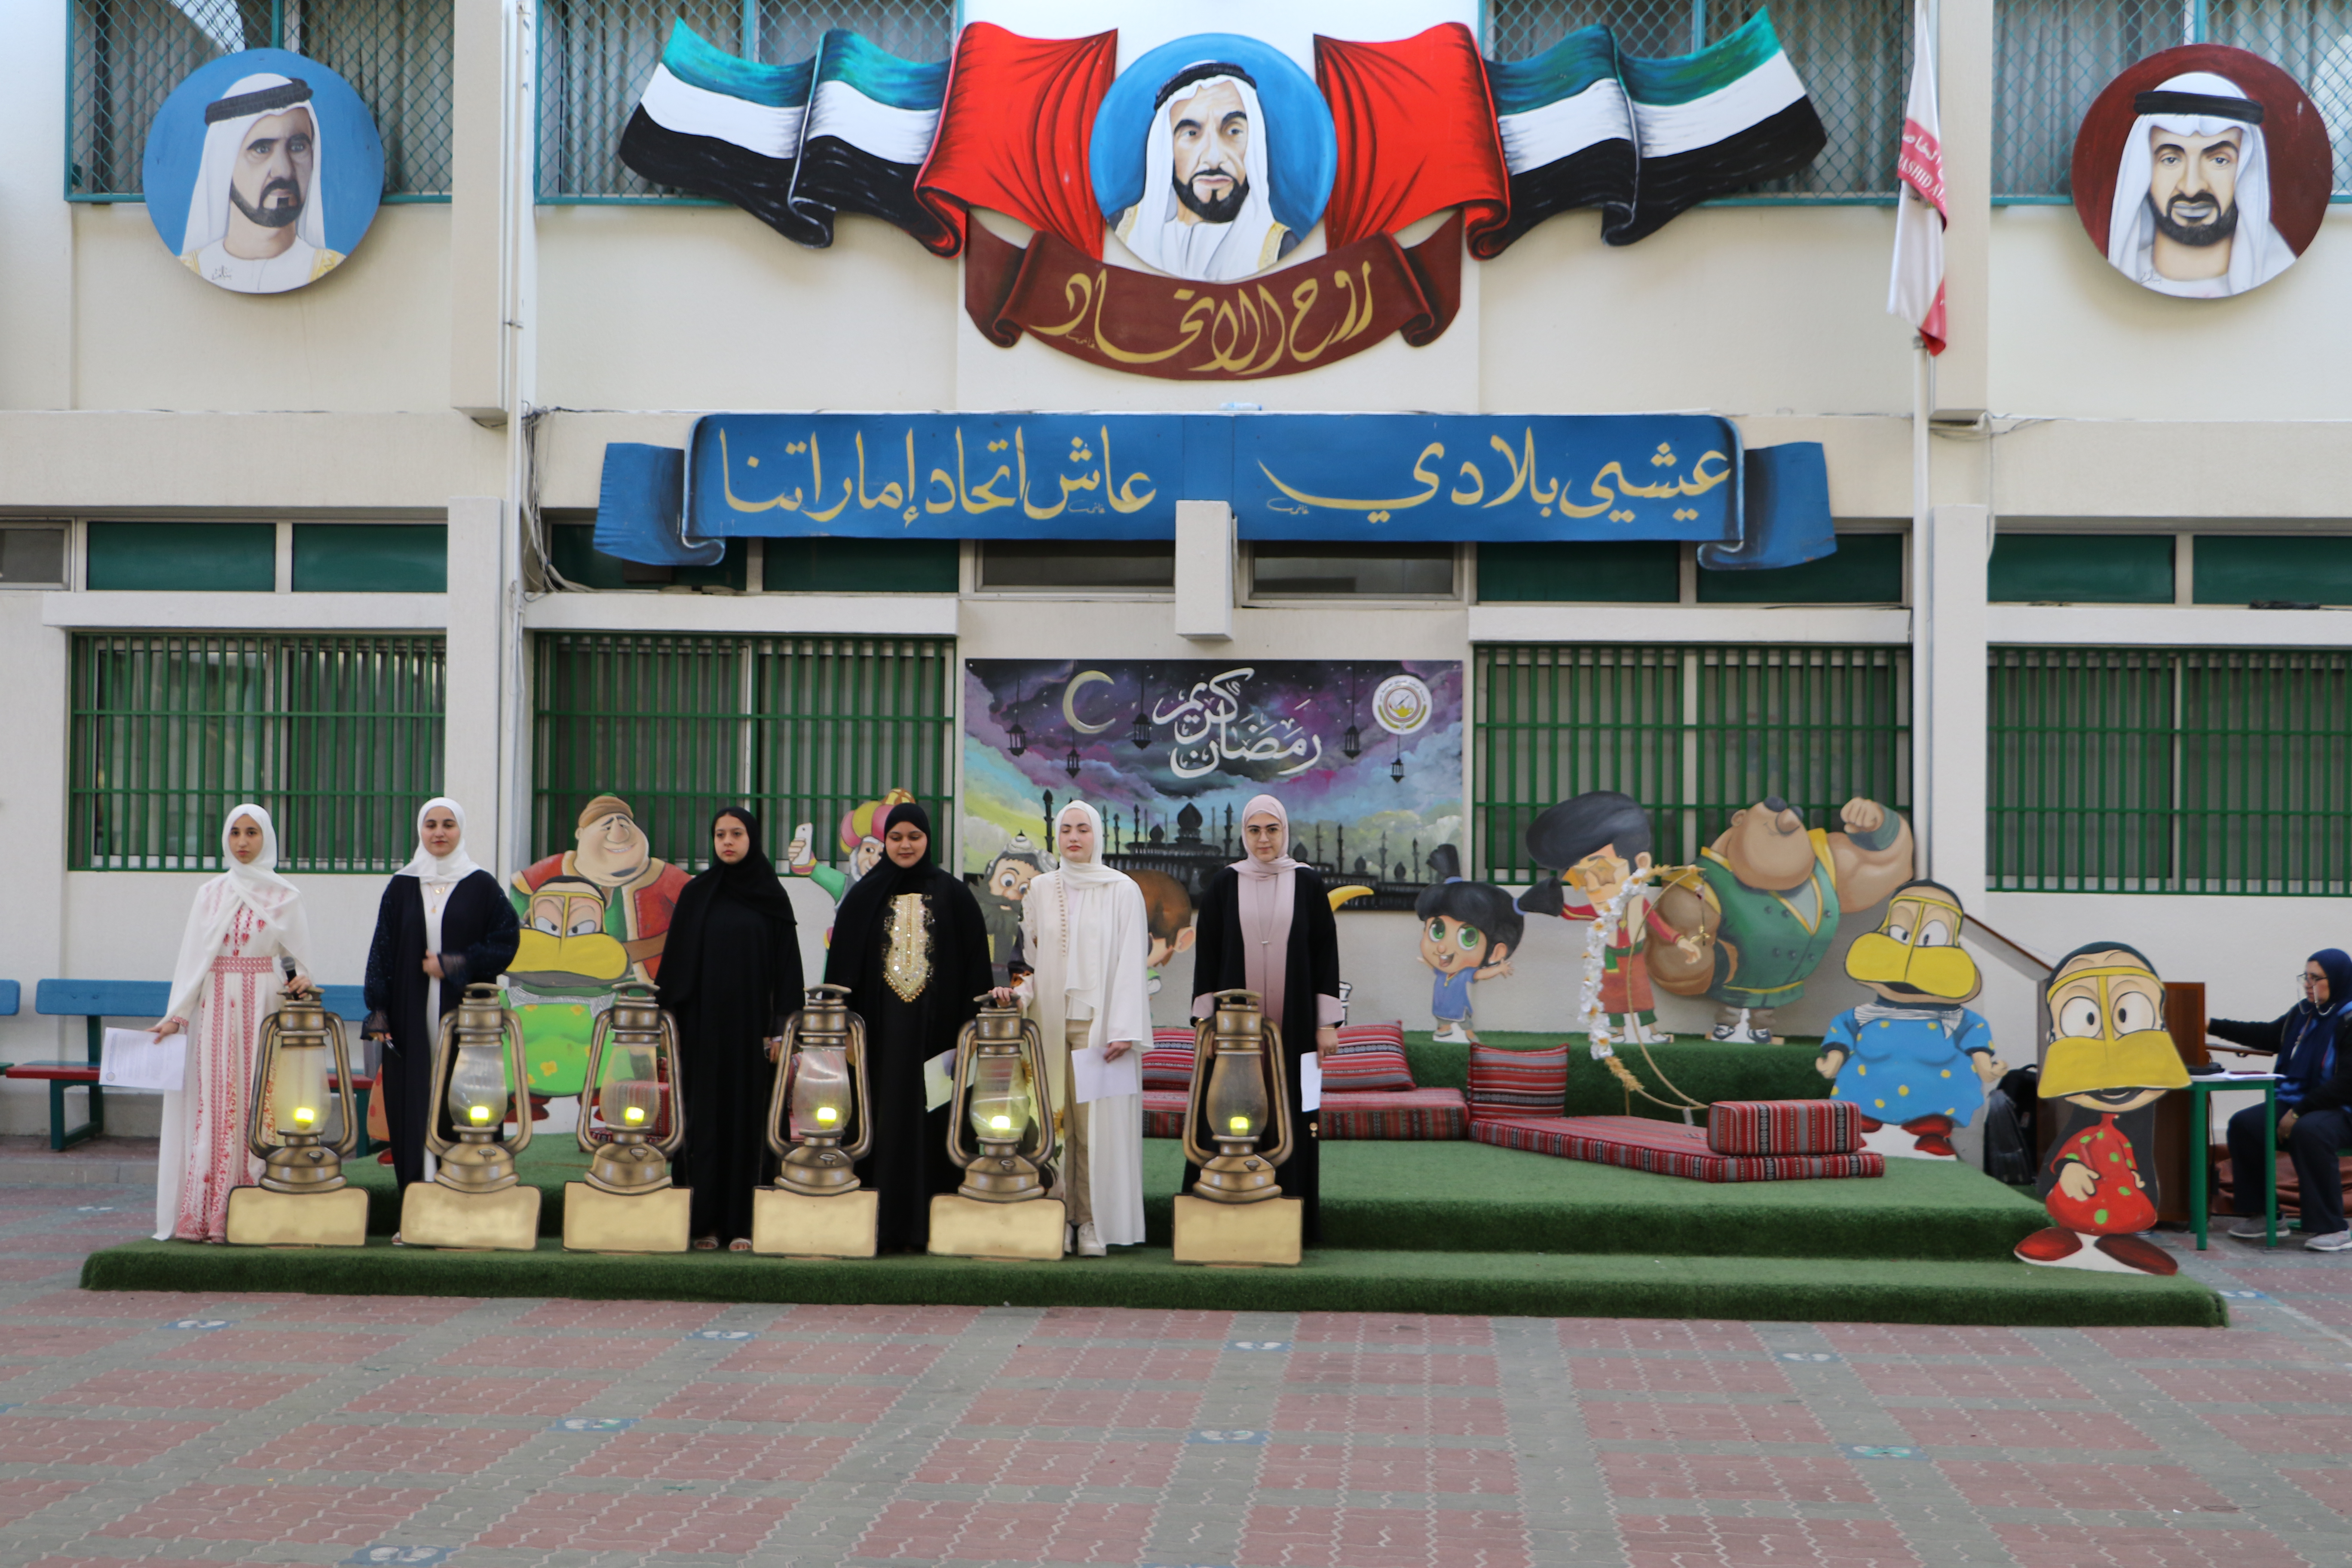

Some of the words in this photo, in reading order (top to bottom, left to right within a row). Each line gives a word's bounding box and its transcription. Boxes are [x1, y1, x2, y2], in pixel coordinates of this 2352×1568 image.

[1288, 260, 1373, 363] روح
[719, 428, 919, 527] إماراتنا
[925, 426, 1026, 515] اتحاد
[1025, 425, 1157, 520] عاش
[1257, 426, 1559, 524] بلادي
[1559, 441, 1731, 523] عيشي
[1152, 668, 1255, 745] كريم
[1169, 698, 1323, 779] رمضان
